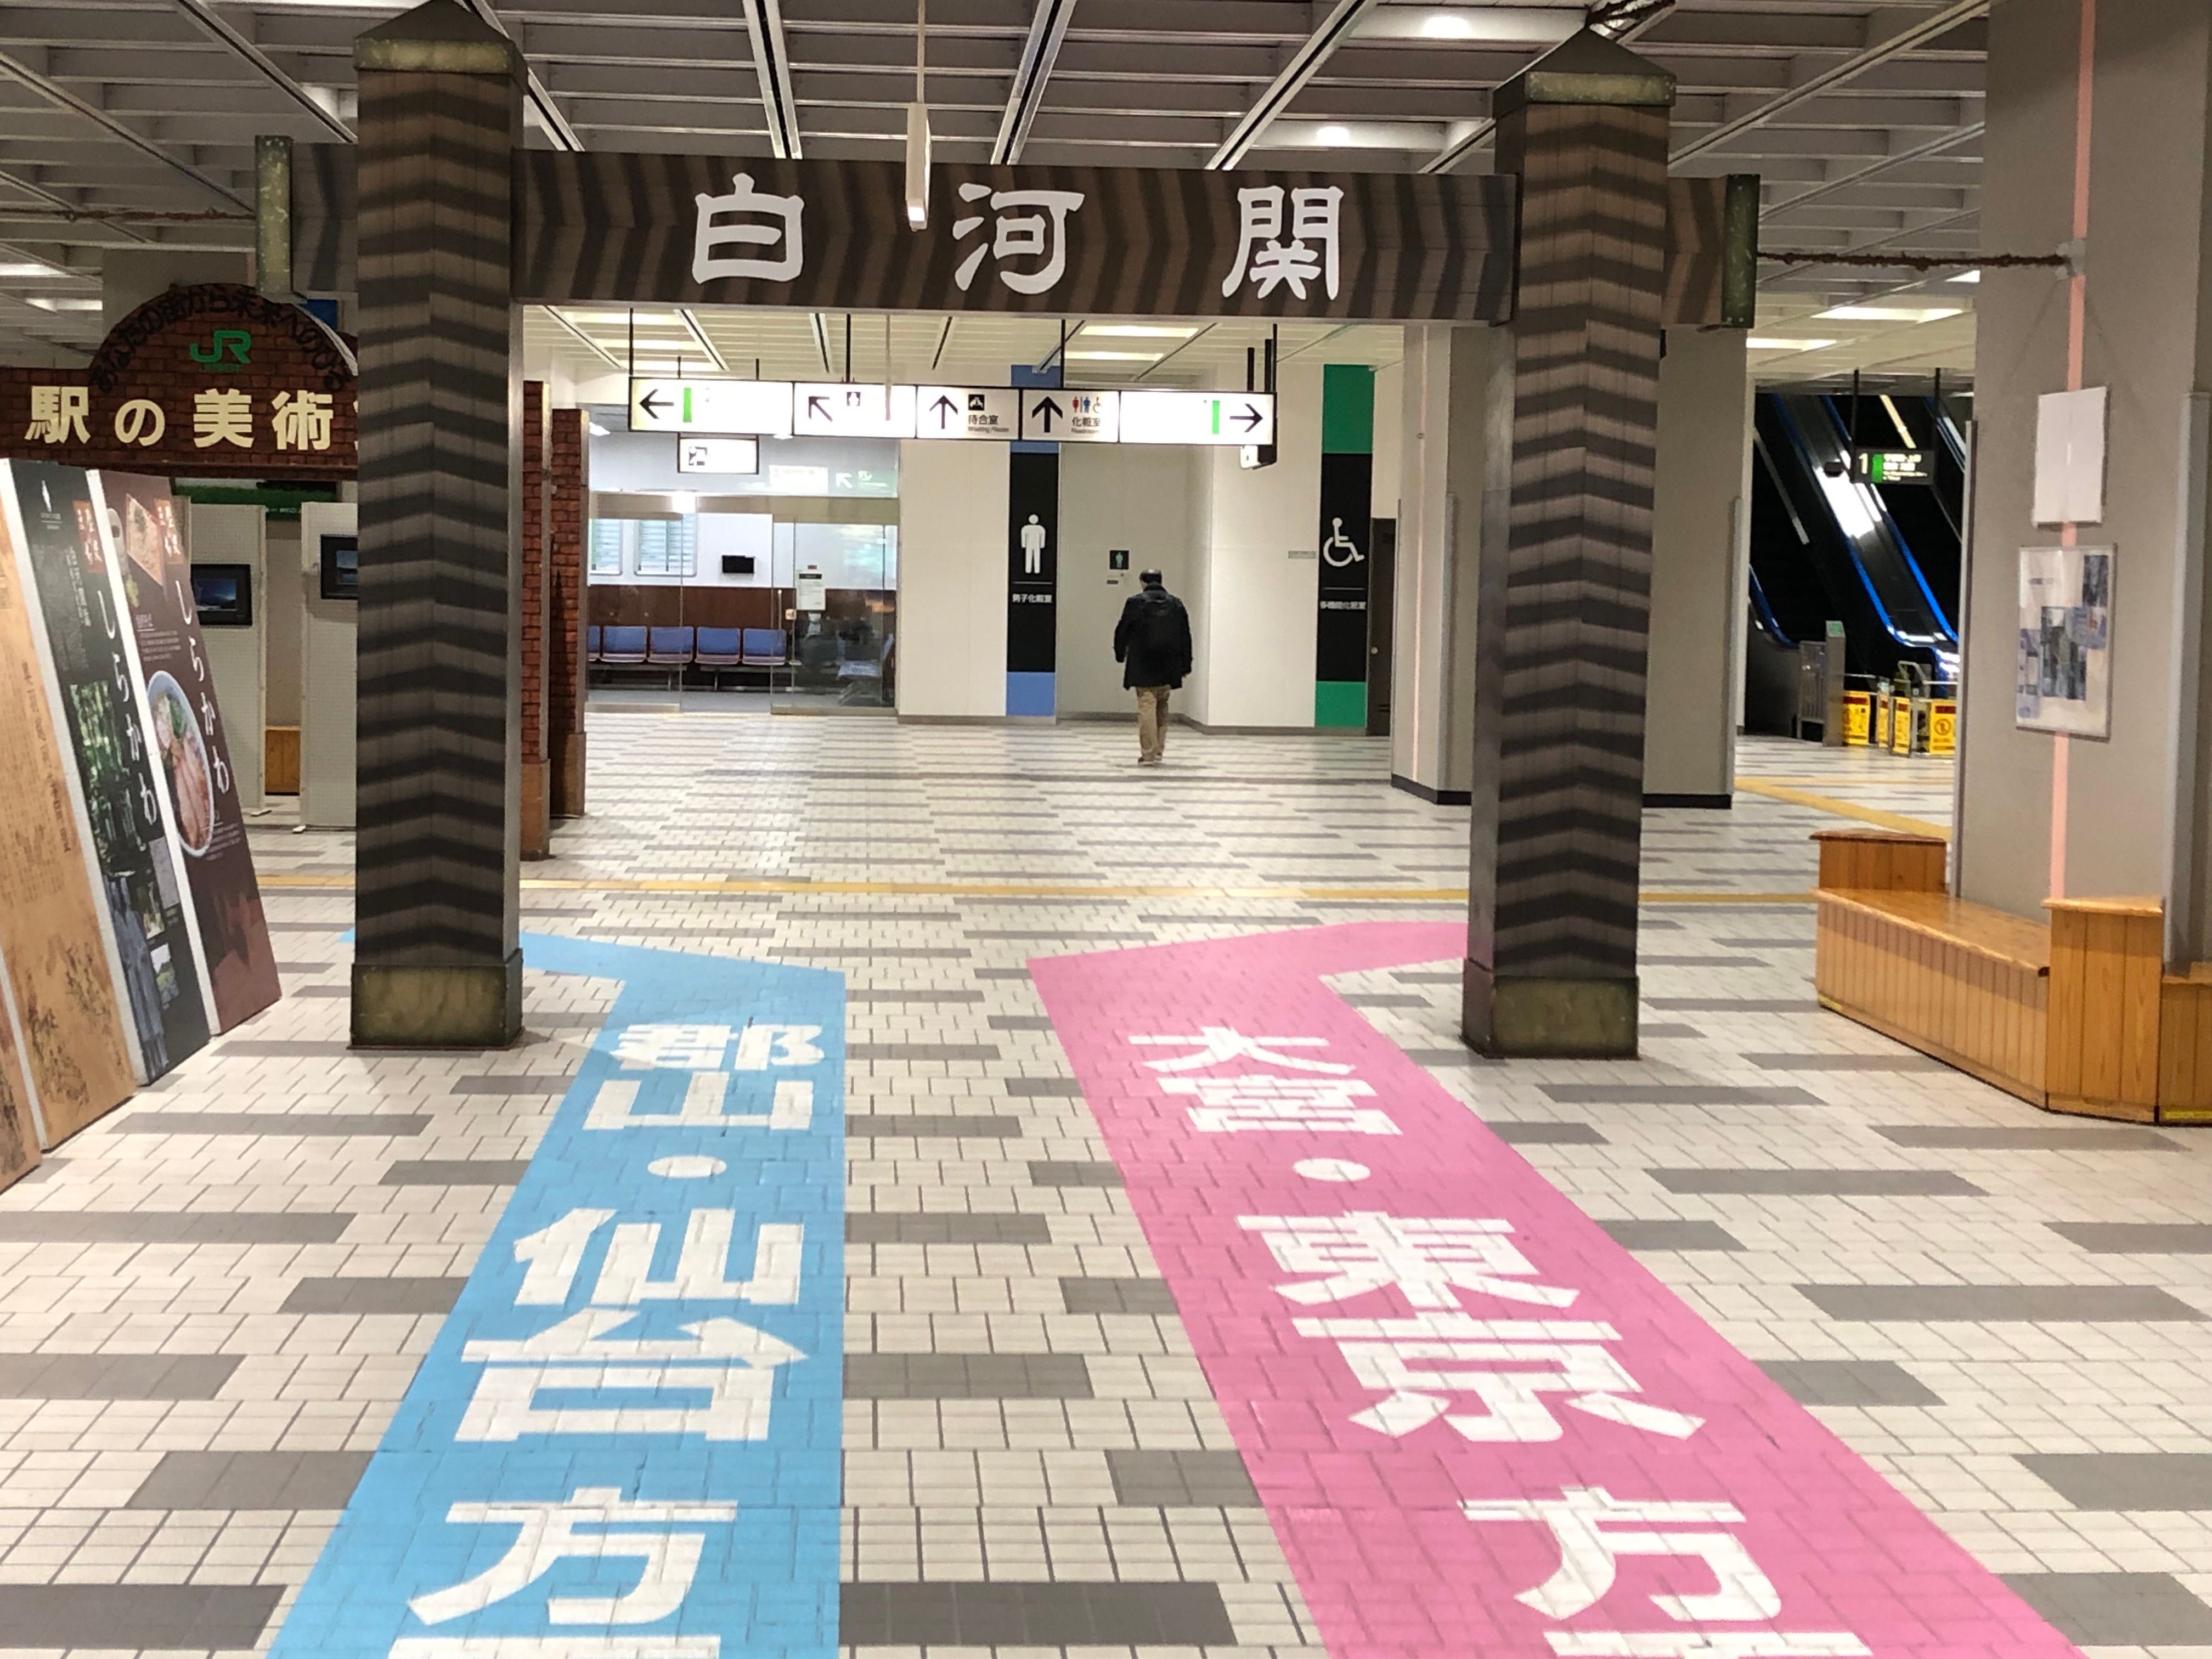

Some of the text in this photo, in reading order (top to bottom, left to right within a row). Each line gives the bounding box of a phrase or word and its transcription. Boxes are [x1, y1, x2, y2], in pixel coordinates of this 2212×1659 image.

[692, 172, 1344, 300] 白河関
[190, 330, 251, 363] JR
[24, 386, 358, 450] 駅の美術
[968, 415, 998, 425] 待合室
[1071, 416, 1101, 427] 化粧室
[1859, 453, 1868, 474] 1
[97, 590, 157, 825] しらかわ
[176, 580, 229, 794] しらかわ
